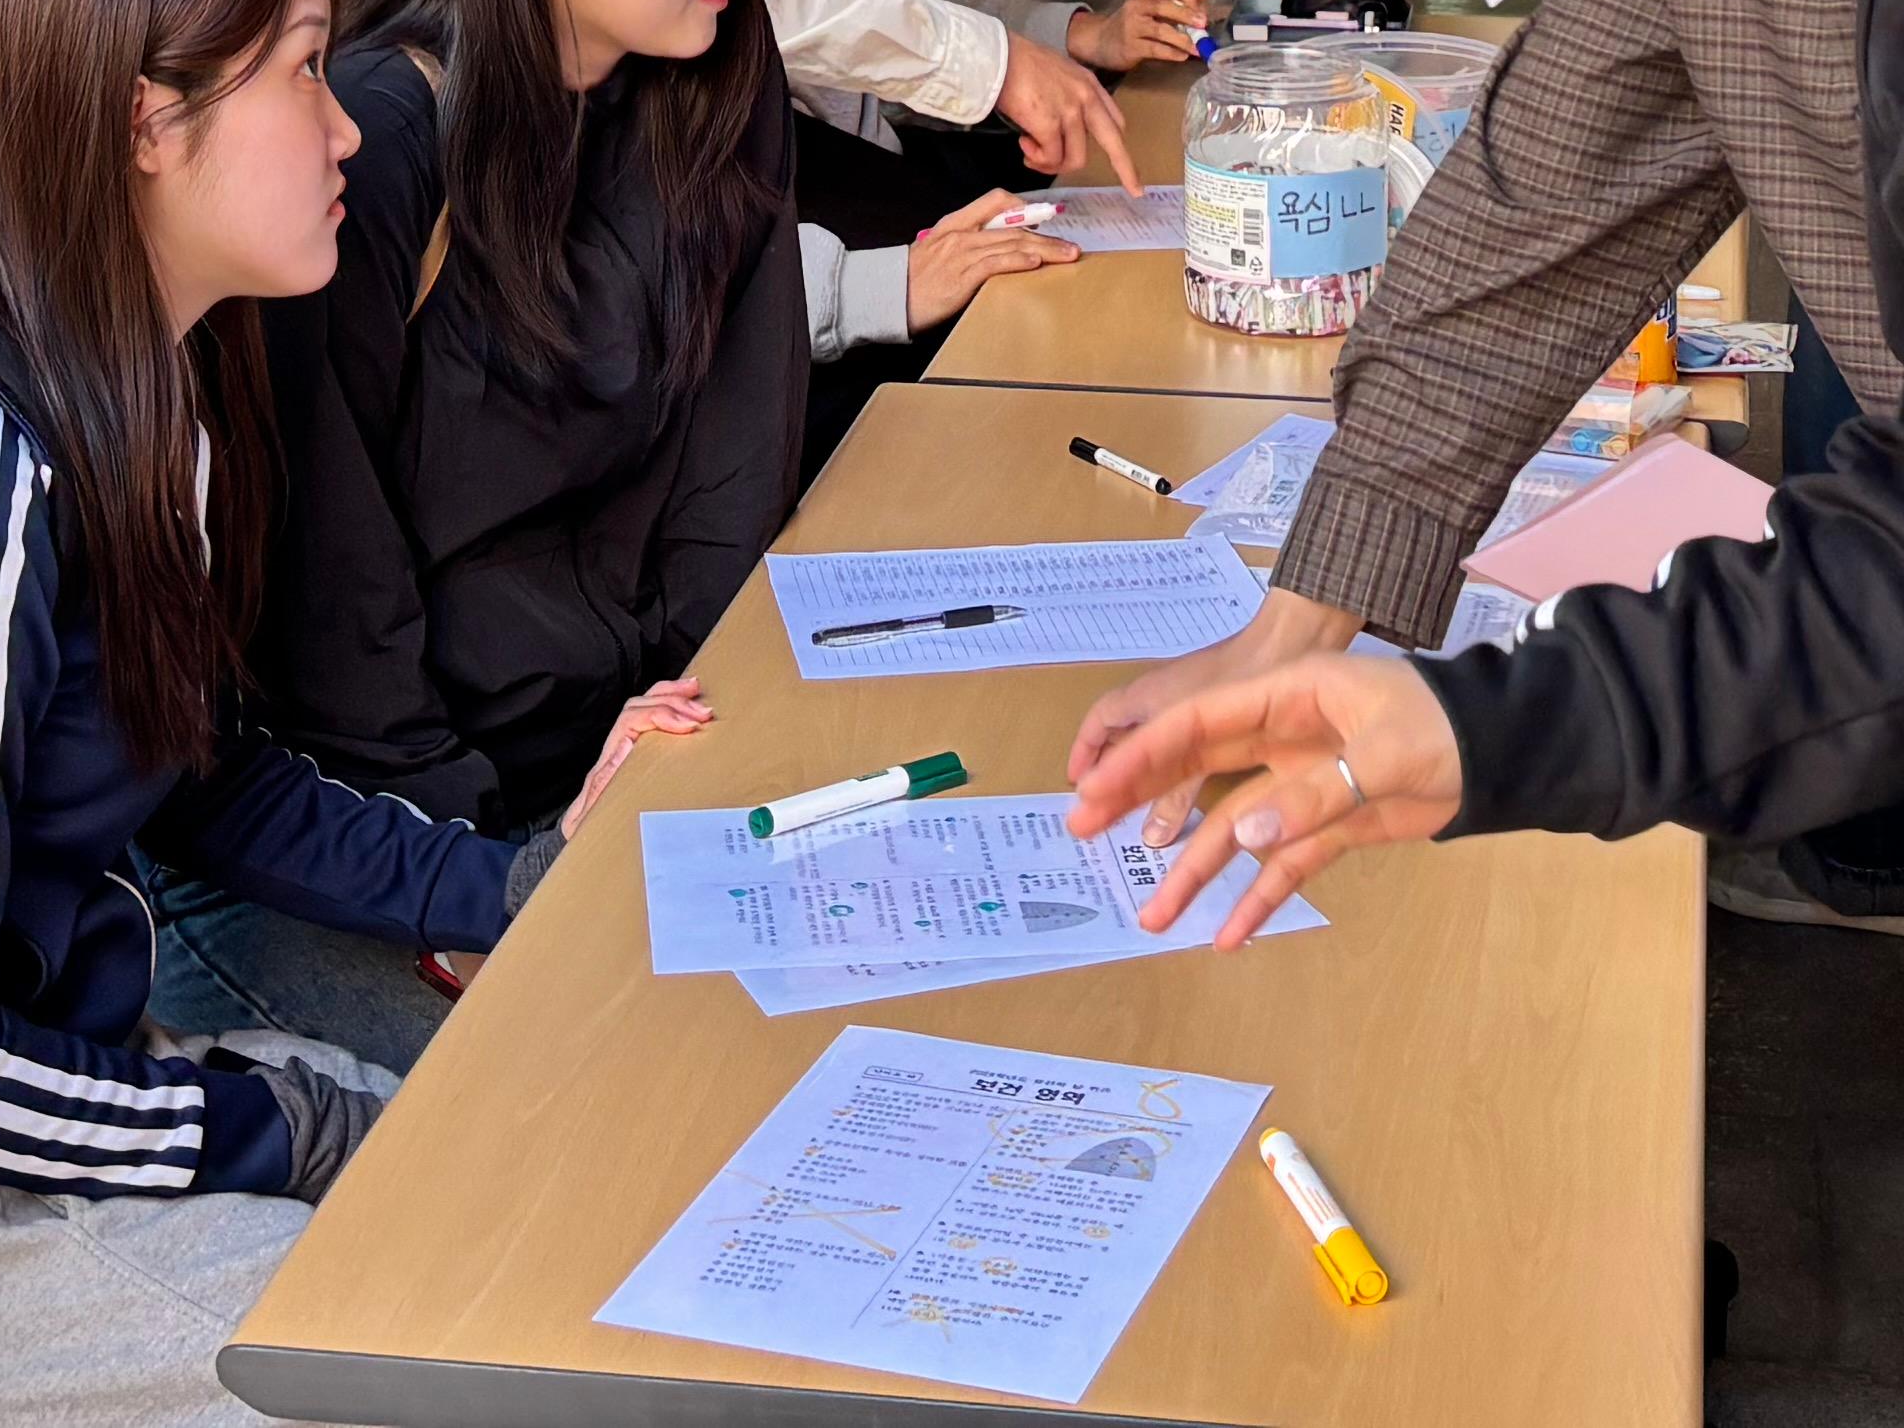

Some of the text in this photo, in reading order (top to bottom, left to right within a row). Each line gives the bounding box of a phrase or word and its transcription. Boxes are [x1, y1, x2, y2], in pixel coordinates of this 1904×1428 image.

[1278, 190, 1331, 236] 욕심
[969, 1078, 1086, 1106] 보건 영역
